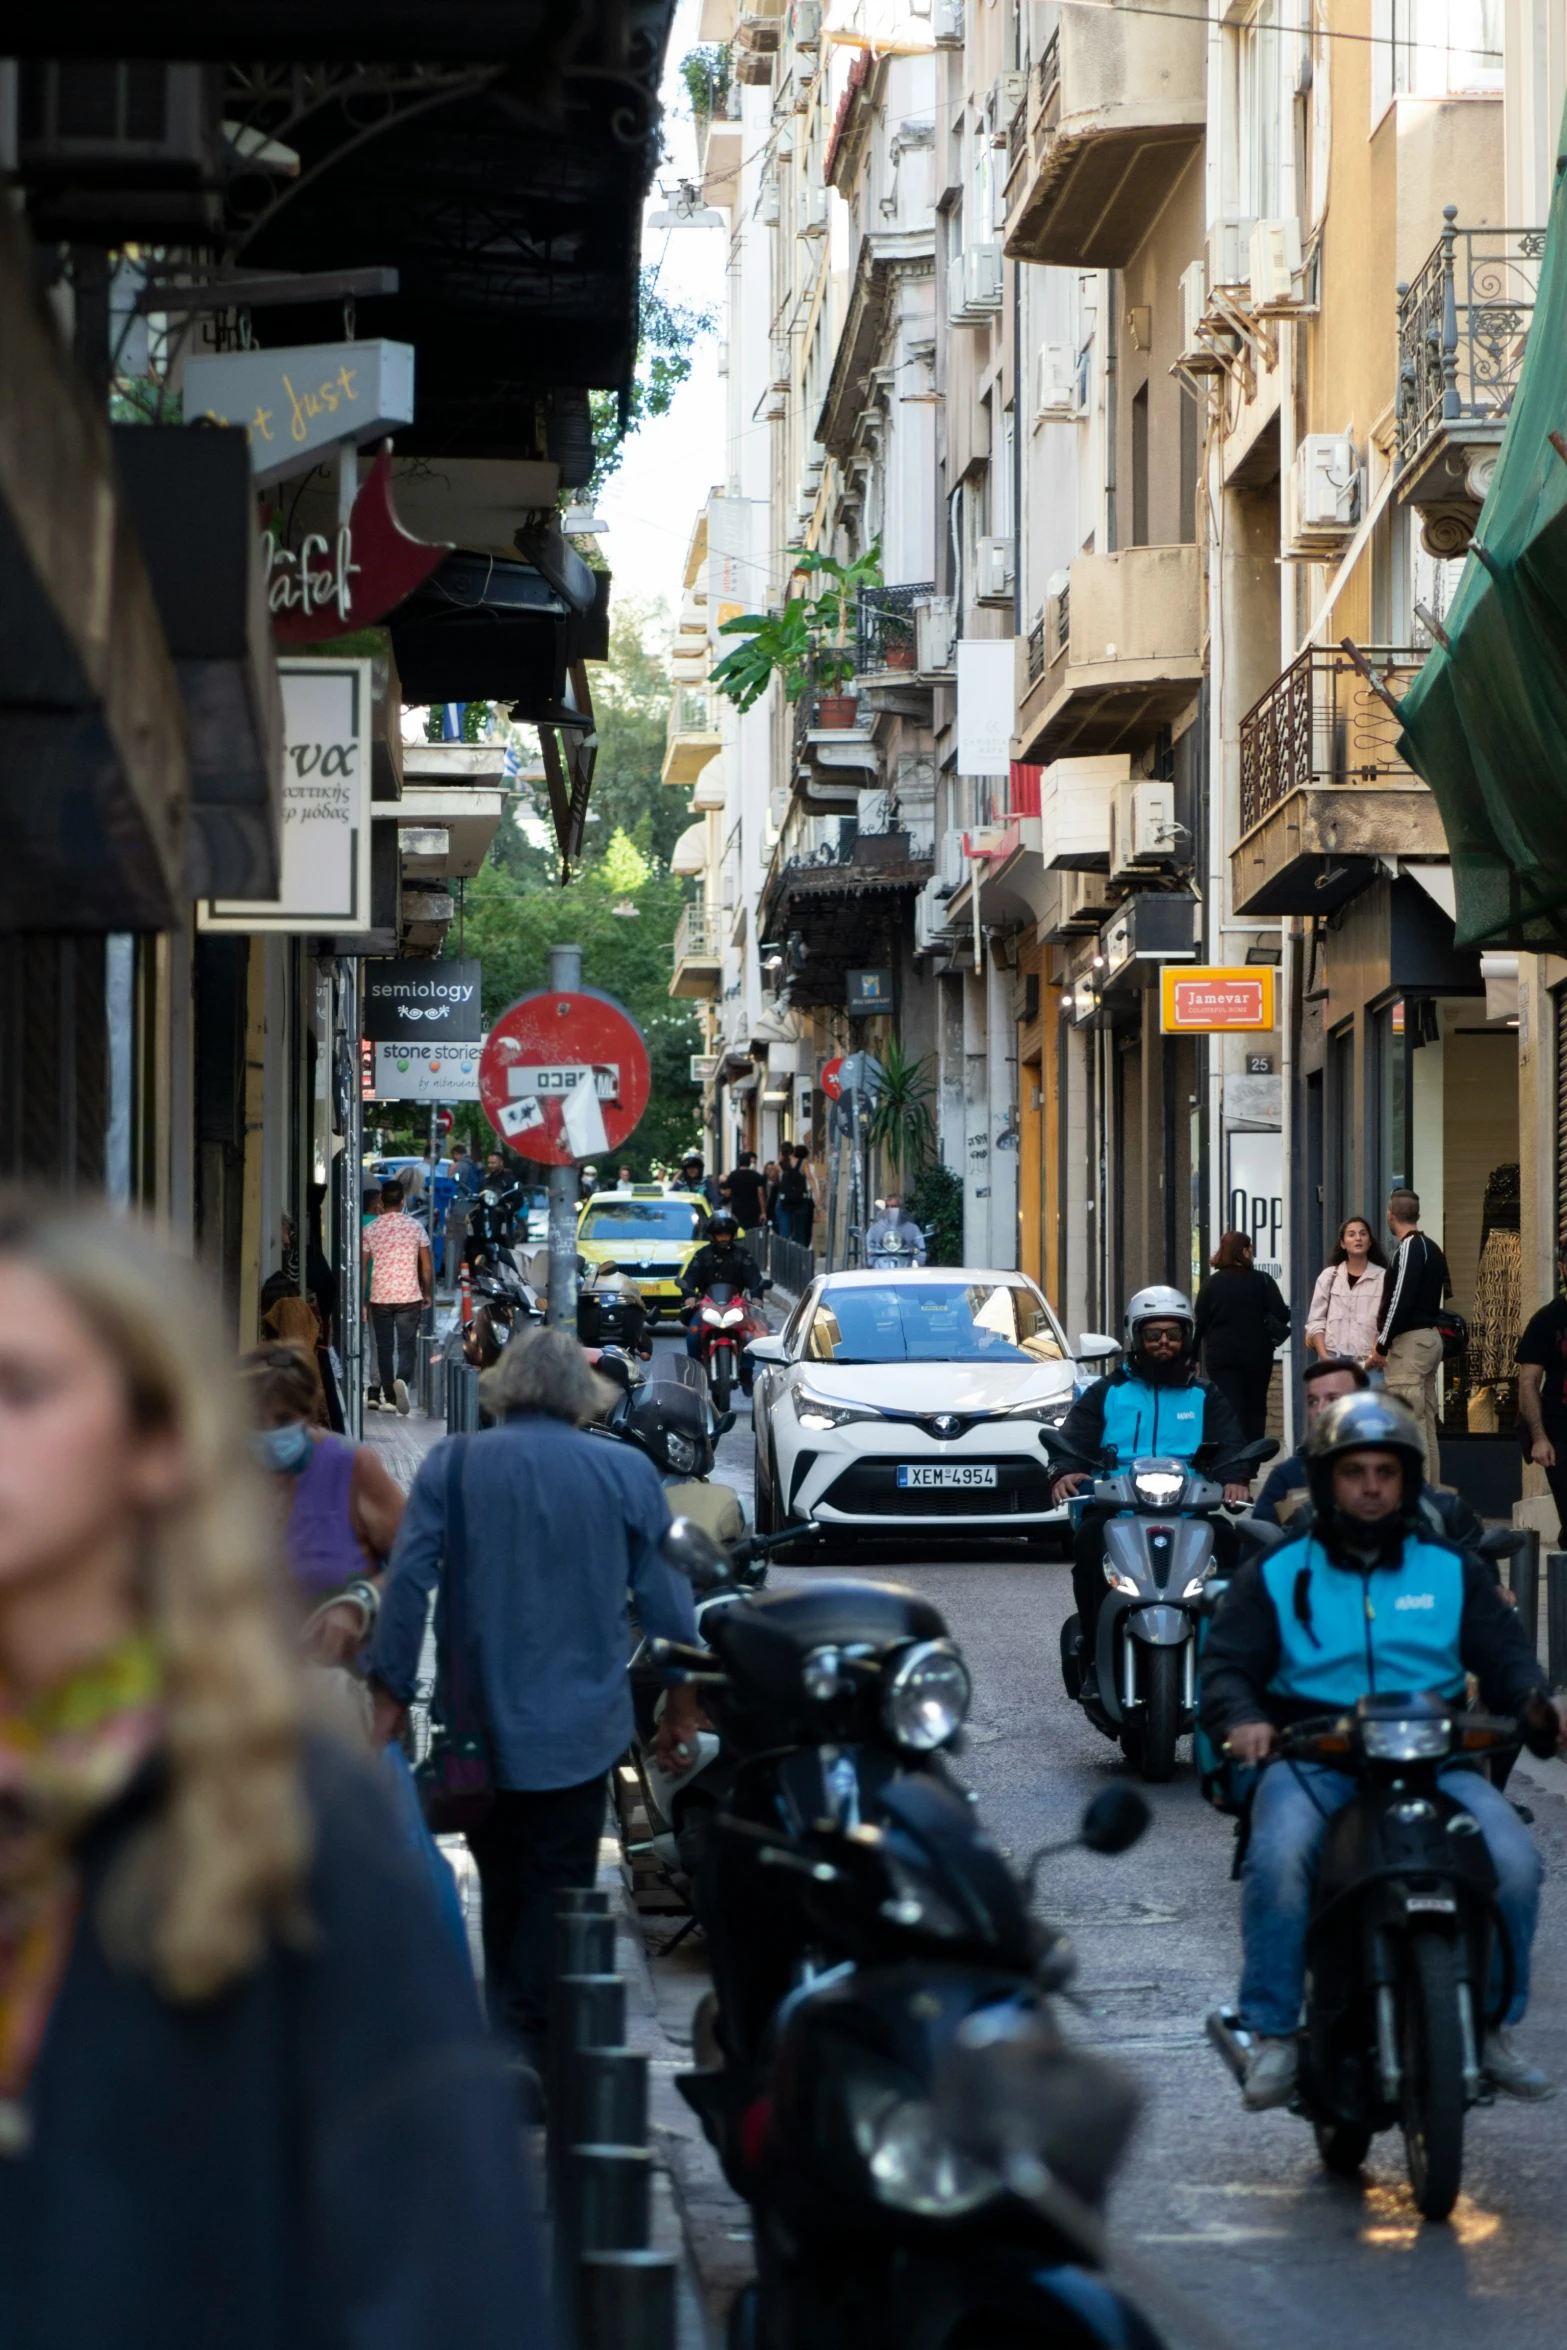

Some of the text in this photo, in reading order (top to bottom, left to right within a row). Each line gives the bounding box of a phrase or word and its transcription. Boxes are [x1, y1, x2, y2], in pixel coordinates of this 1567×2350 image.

[282, 364, 358, 441] Just
[371, 981, 473, 1002] semiology
[1188, 992, 1250, 1005] Jamevar
[384, 1044, 431, 1059] stone
[1251, 1058, 1269, 1071] 25
[912, 1468, 994, 1485] XEM-4954
